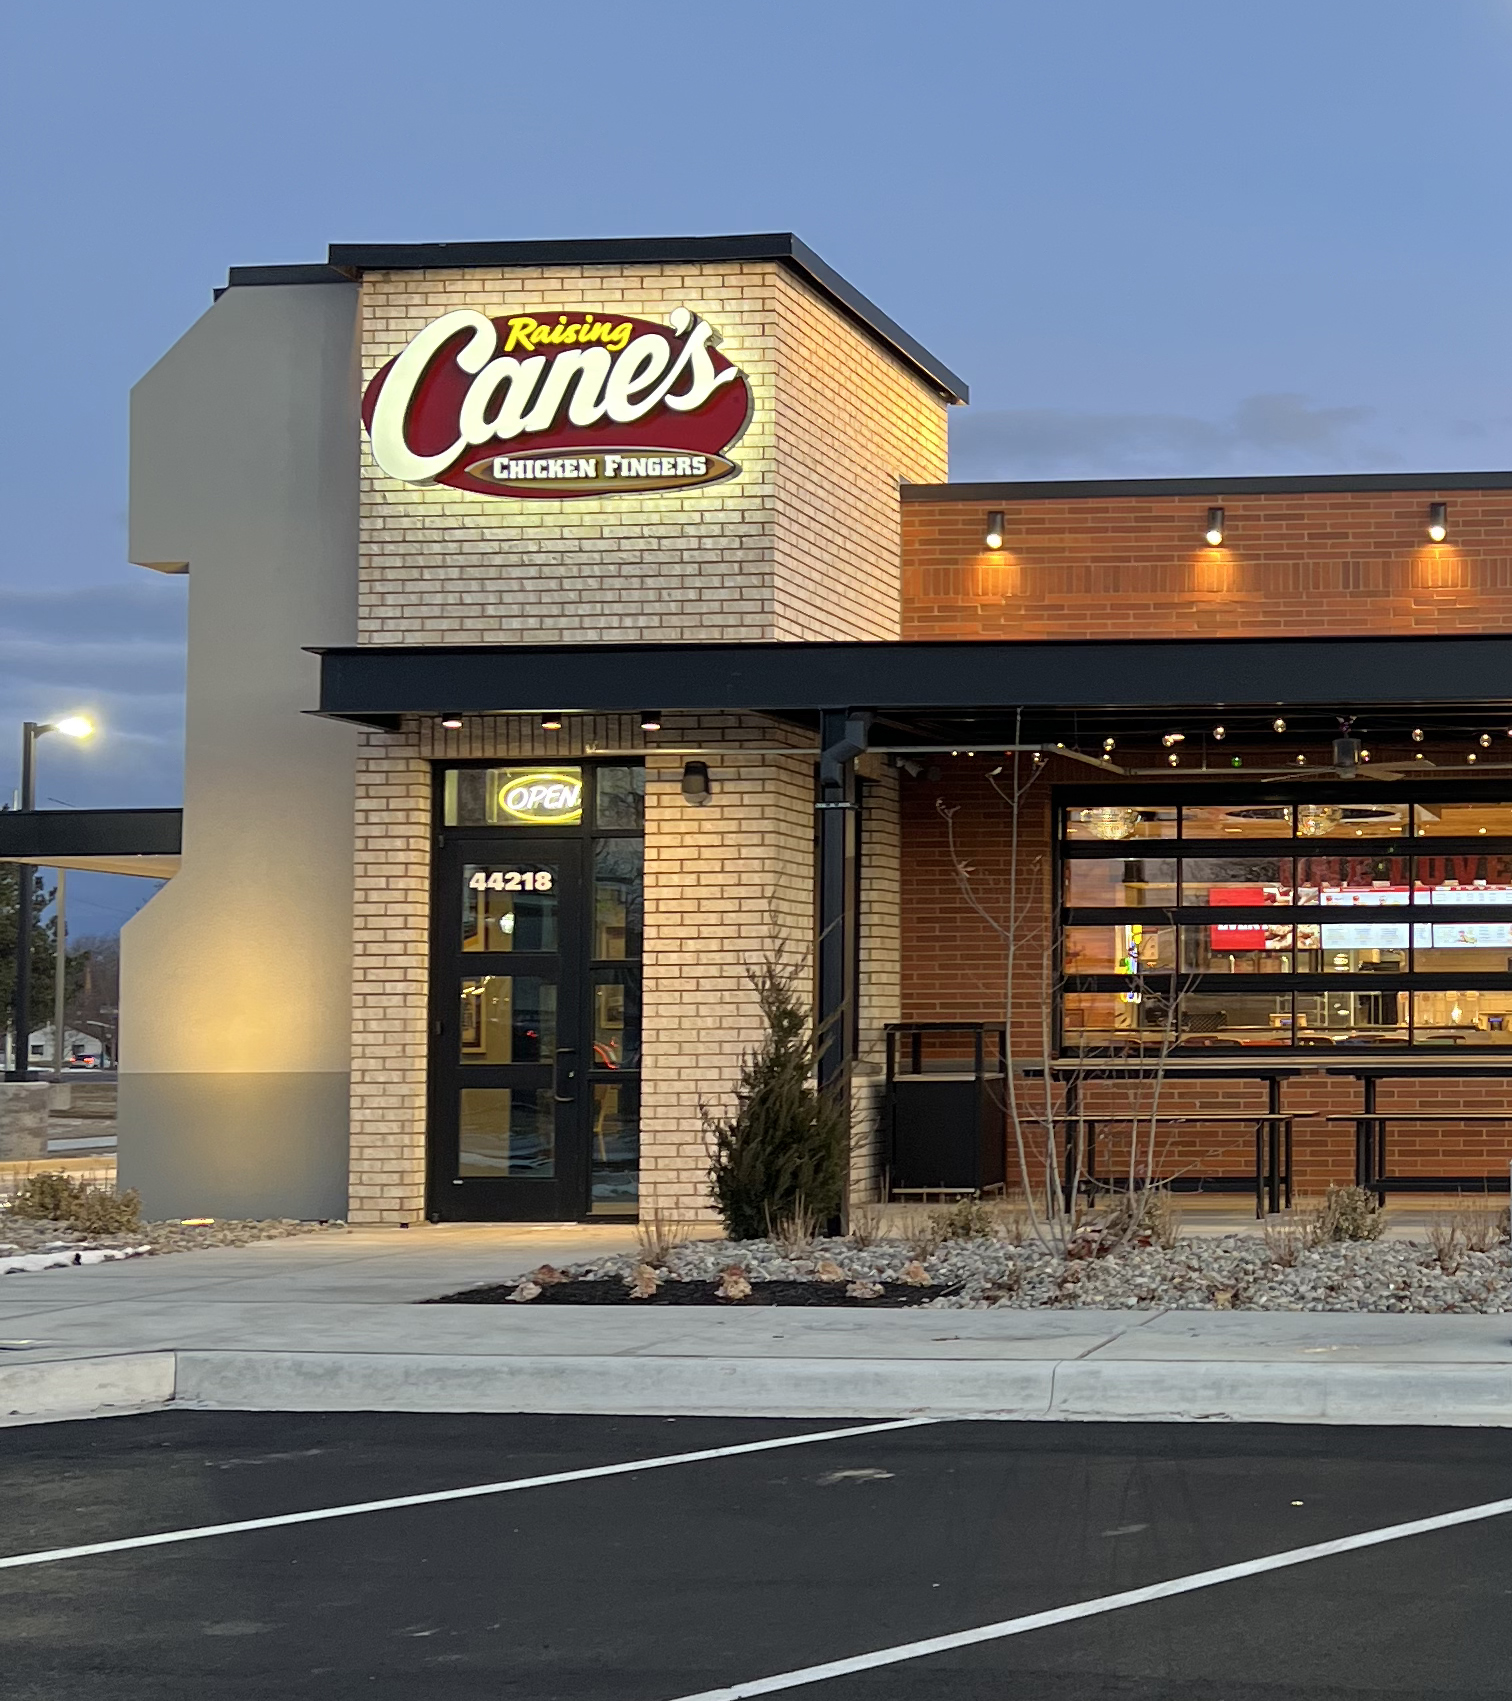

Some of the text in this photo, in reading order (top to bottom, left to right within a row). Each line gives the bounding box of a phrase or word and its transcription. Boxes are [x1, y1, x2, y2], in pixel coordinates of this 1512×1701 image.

[504, 314, 635, 353] Raising
[371, 306, 740, 482] Cane's
[493, 453, 708, 480] CHICKEN FINGERS
[507, 783, 581, 810] OPEN
[469, 871, 553, 891] 44218
